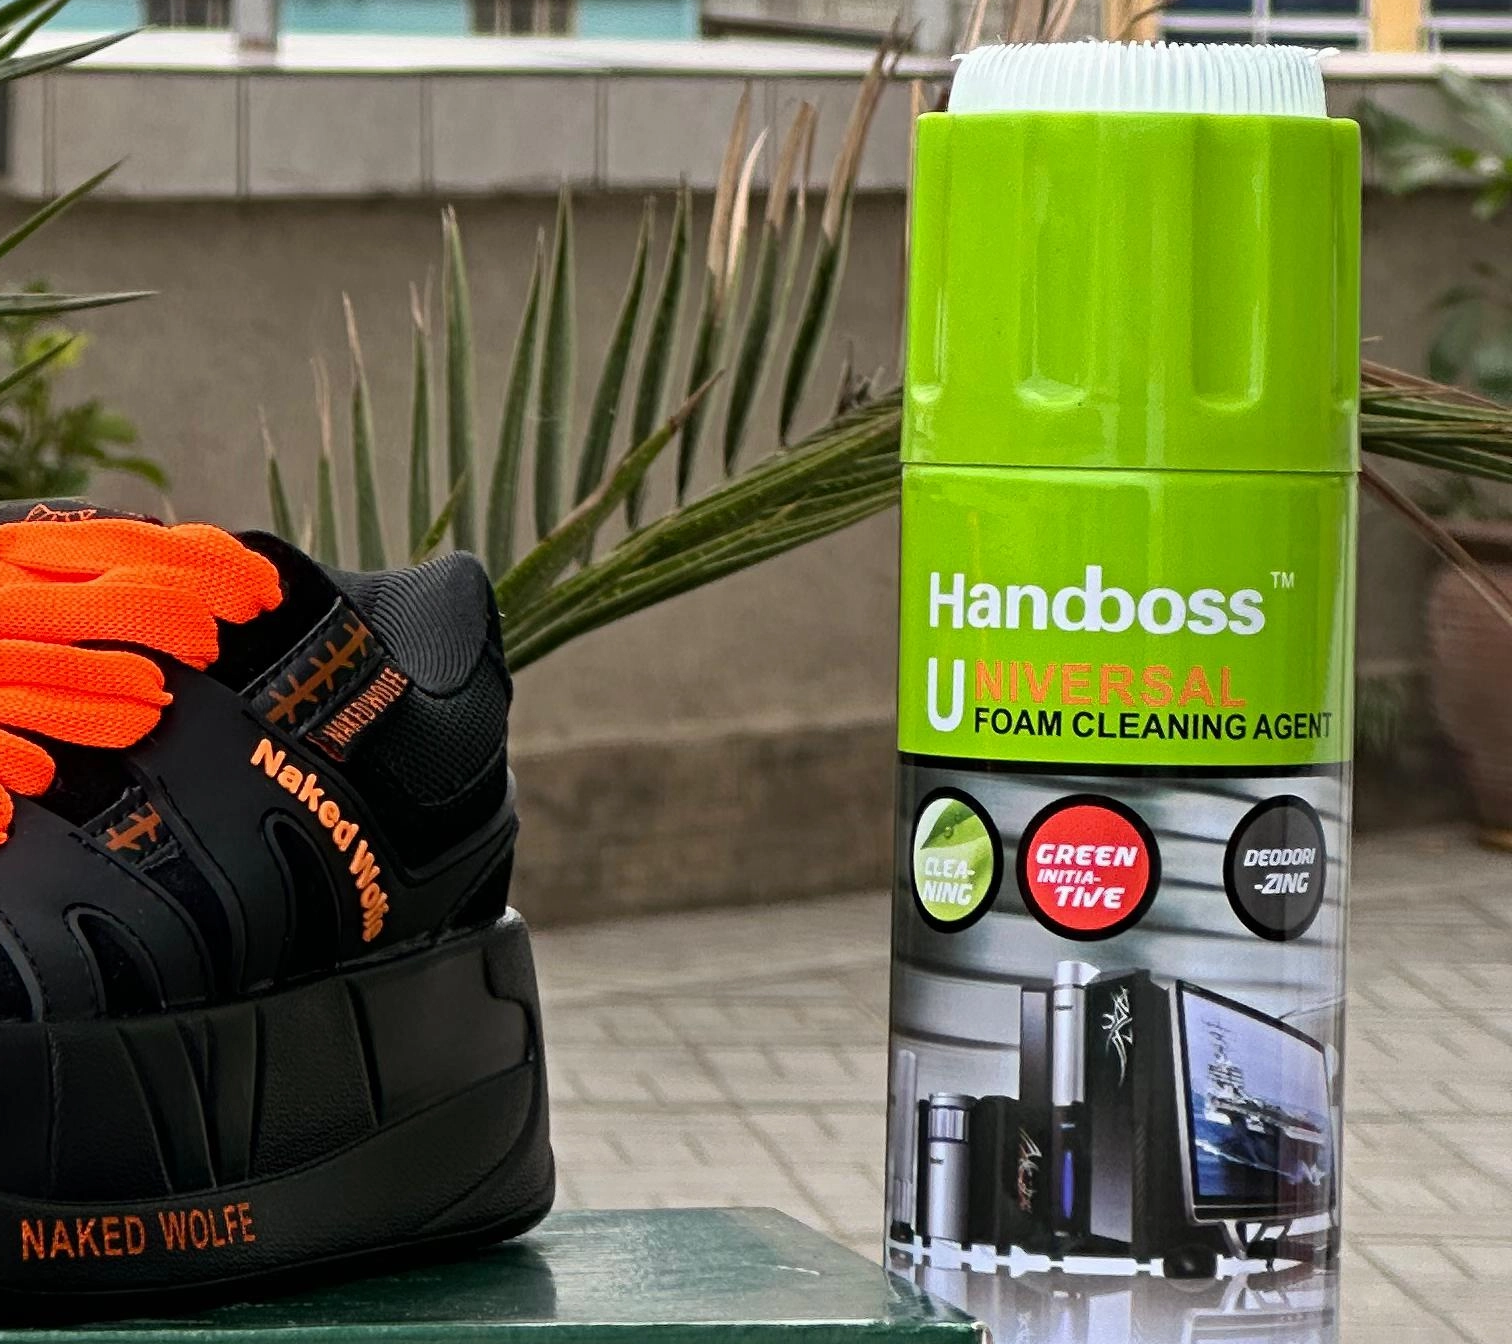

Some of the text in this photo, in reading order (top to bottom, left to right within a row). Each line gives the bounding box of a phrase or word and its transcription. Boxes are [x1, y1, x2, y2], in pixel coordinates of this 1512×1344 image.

[928, 565, 1266, 635] Handboss
[974, 707, 1333, 741] FOAM CLEANING AGENT
[250, 738, 359, 852] Naked
[924, 856, 976, 879] CLEA-
[1035, 843, 1139, 868] GREEN
[1243, 847, 1317, 868] DEODORI
[1036, 868, 1102, 885] INITIA-
[922, 880, 974, 906] NING
[1053, 885, 1127, 910] TIVE
[20, 1202, 257, 1261] NAKED WOLFE
